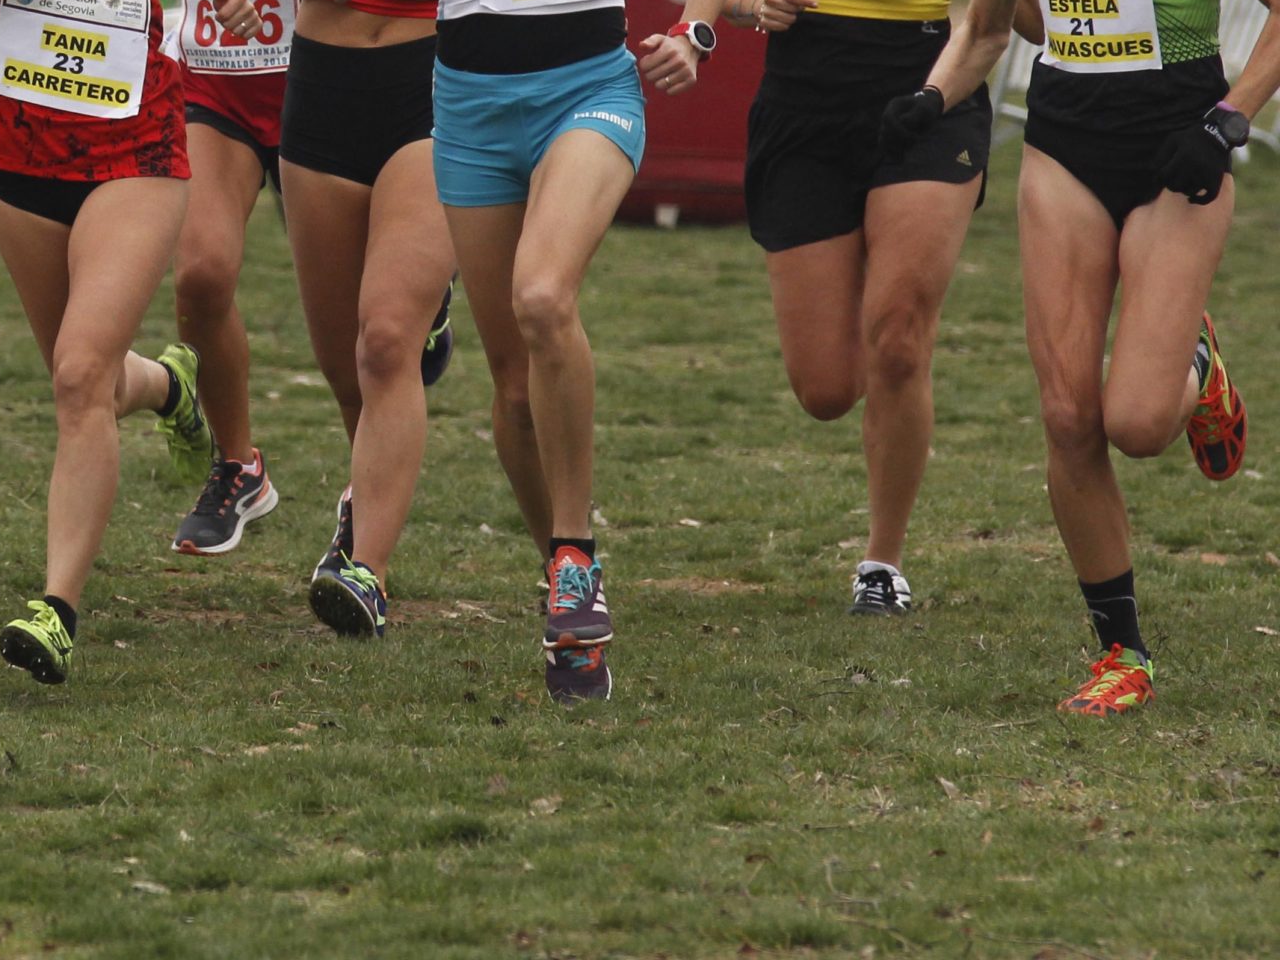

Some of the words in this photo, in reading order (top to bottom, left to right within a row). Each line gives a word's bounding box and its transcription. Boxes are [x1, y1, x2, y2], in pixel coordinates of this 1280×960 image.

[39, 0, 53, 9] de
[55, 3, 96, 17] Segovia
[1070, 18, 1095, 36] 21
[42, 29, 107, 57] TANIA
[235, 46, 282, 57] NACIONAL
[52, 53, 84, 74] 23
[194, 58, 256, 69] CANTIMPALOS
[3, 65, 131, 104] CARRETERO
